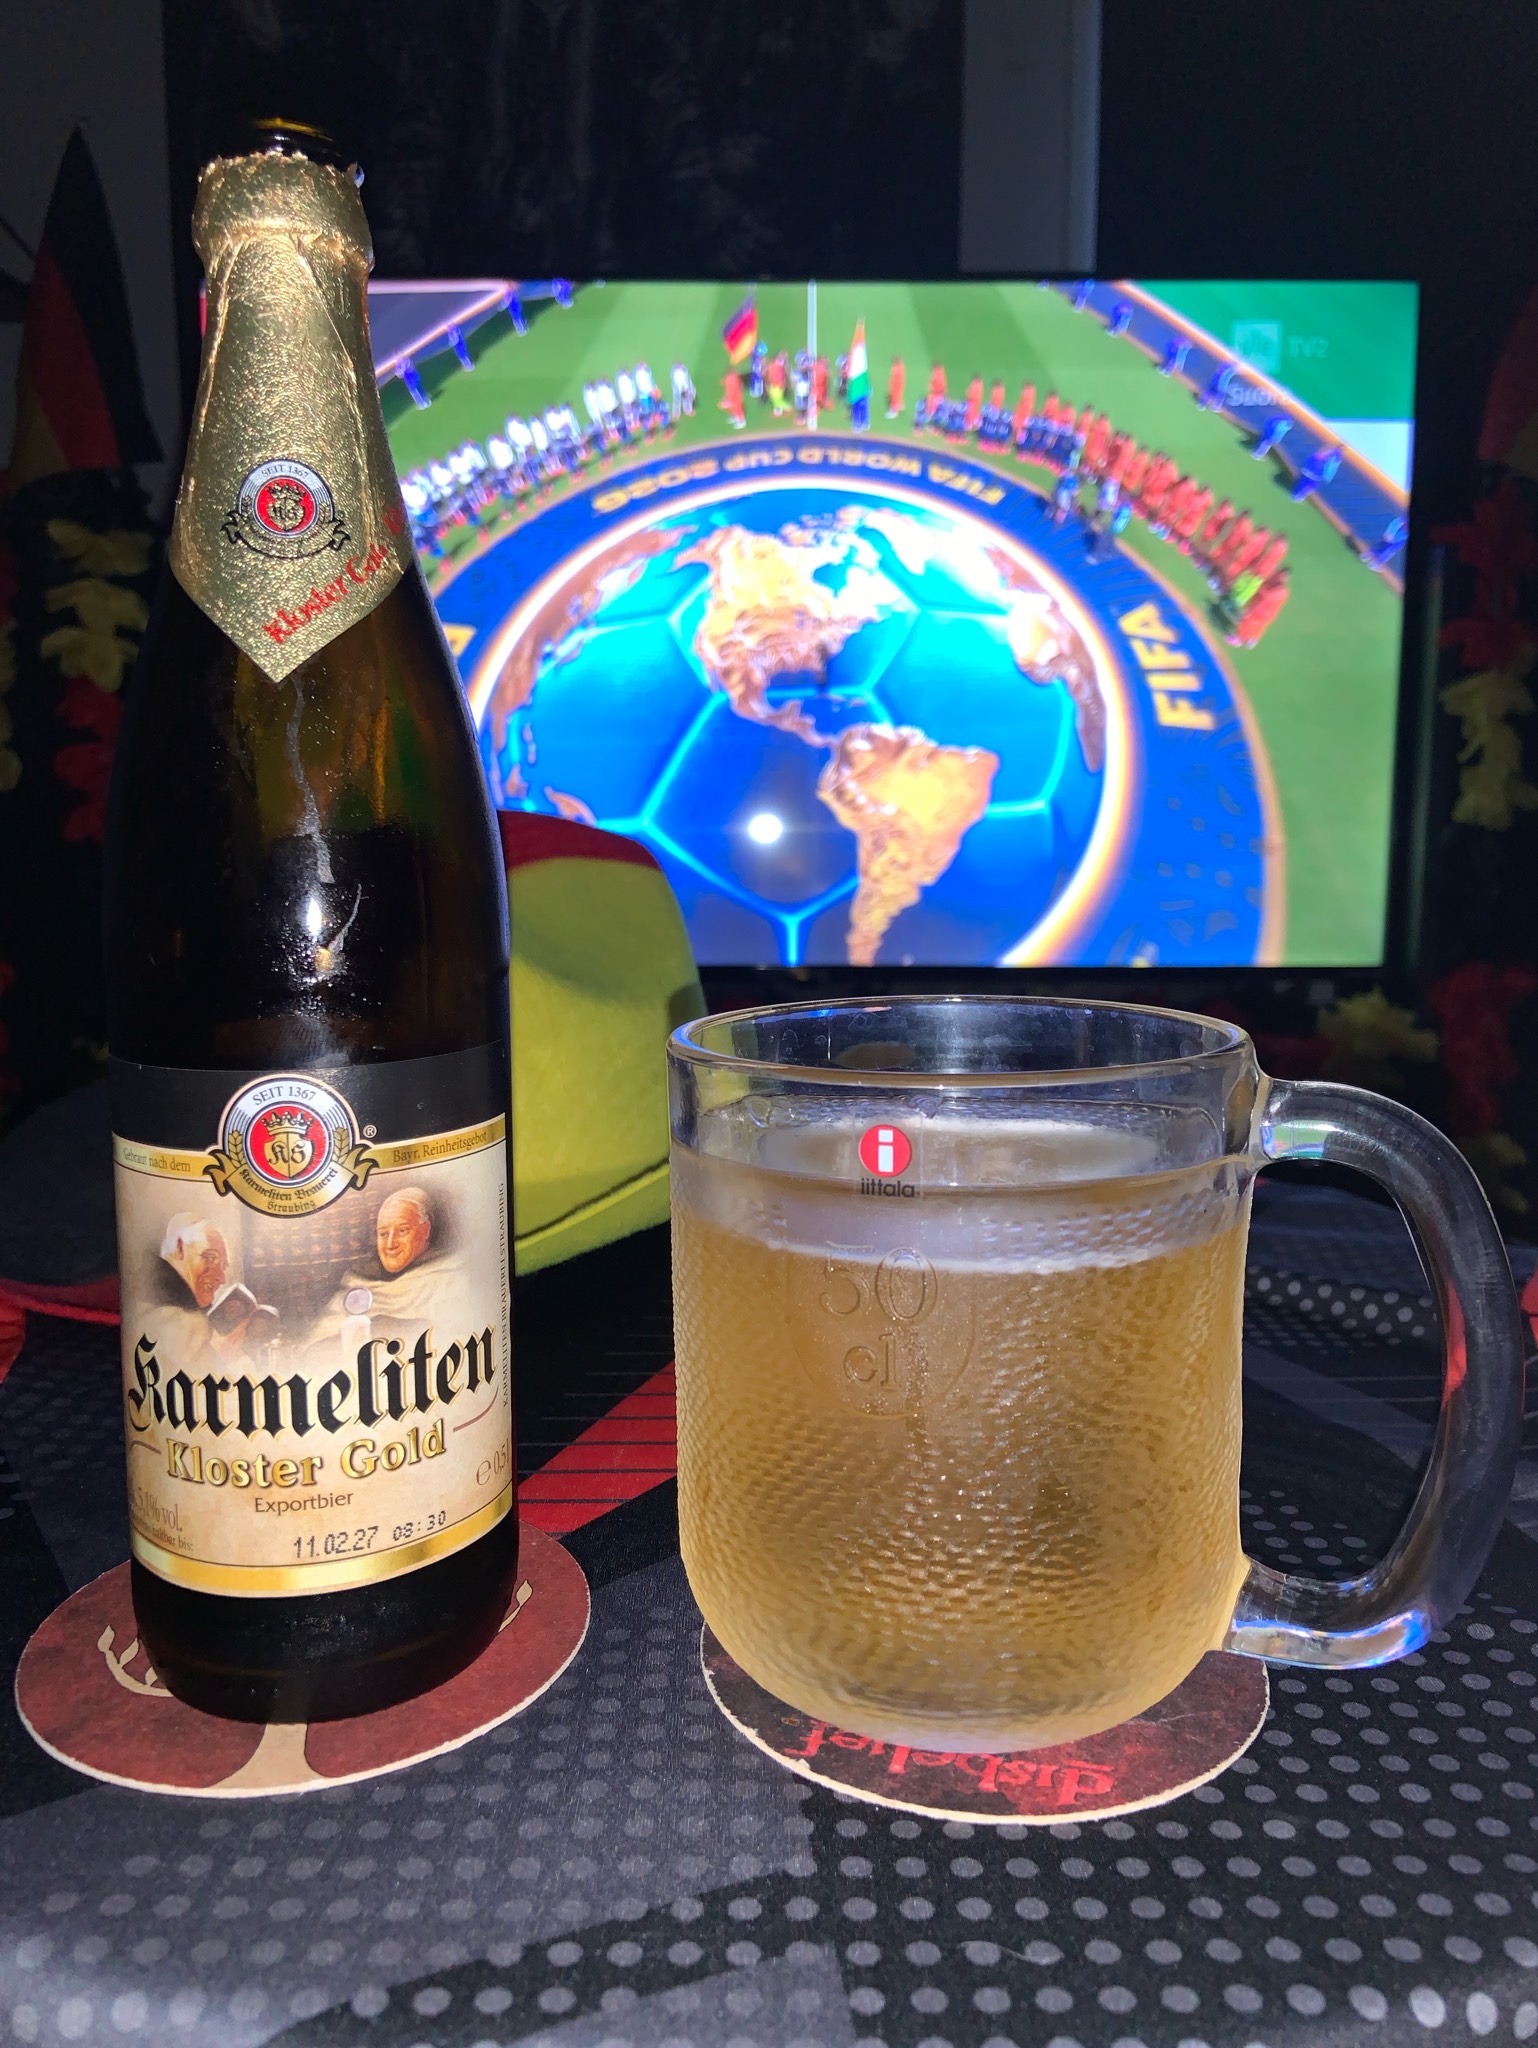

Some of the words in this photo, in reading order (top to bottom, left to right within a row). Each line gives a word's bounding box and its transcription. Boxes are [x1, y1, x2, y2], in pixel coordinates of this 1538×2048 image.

[261, 464, 285, 478] SEIT
[288, 465, 309, 479] 1367
[723, 447, 794, 472] CUP
[797, 446, 922, 477] WORLD
[928, 462, 1006, 506] FIFA
[263, 575, 350, 643] Kloster
[1118, 601, 1216, 731] FIFA
[252, 1085, 284, 1106] SEIT
[288, 1085, 317, 1101] 1367
[393, 1149, 420, 1165] Bayr.
[423, 1131, 487, 1157] Reinheitsgebot
[149, 1155, 168, 1170] nach
[169, 1157, 192, 1172] dem
[239, 1167, 292, 1201] Karmeliten
[294, 1166, 339, 1200] Brauerei
[861, 1178, 915, 1198] iittala
[267, 1199, 316, 1213] Straubing
[128, 1324, 497, 1439] Karmeliten
[166, 1437, 323, 1490] Kloster
[340, 1417, 447, 1480] Gold
[162, 1503, 182, 1532] vol.
[255, 1492, 354, 1516] Exportbier
[178, 1534, 193, 1551] bis:
[294, 1525, 379, 1558] 11.02.27
[393, 1510, 446, 1541] 08:30
